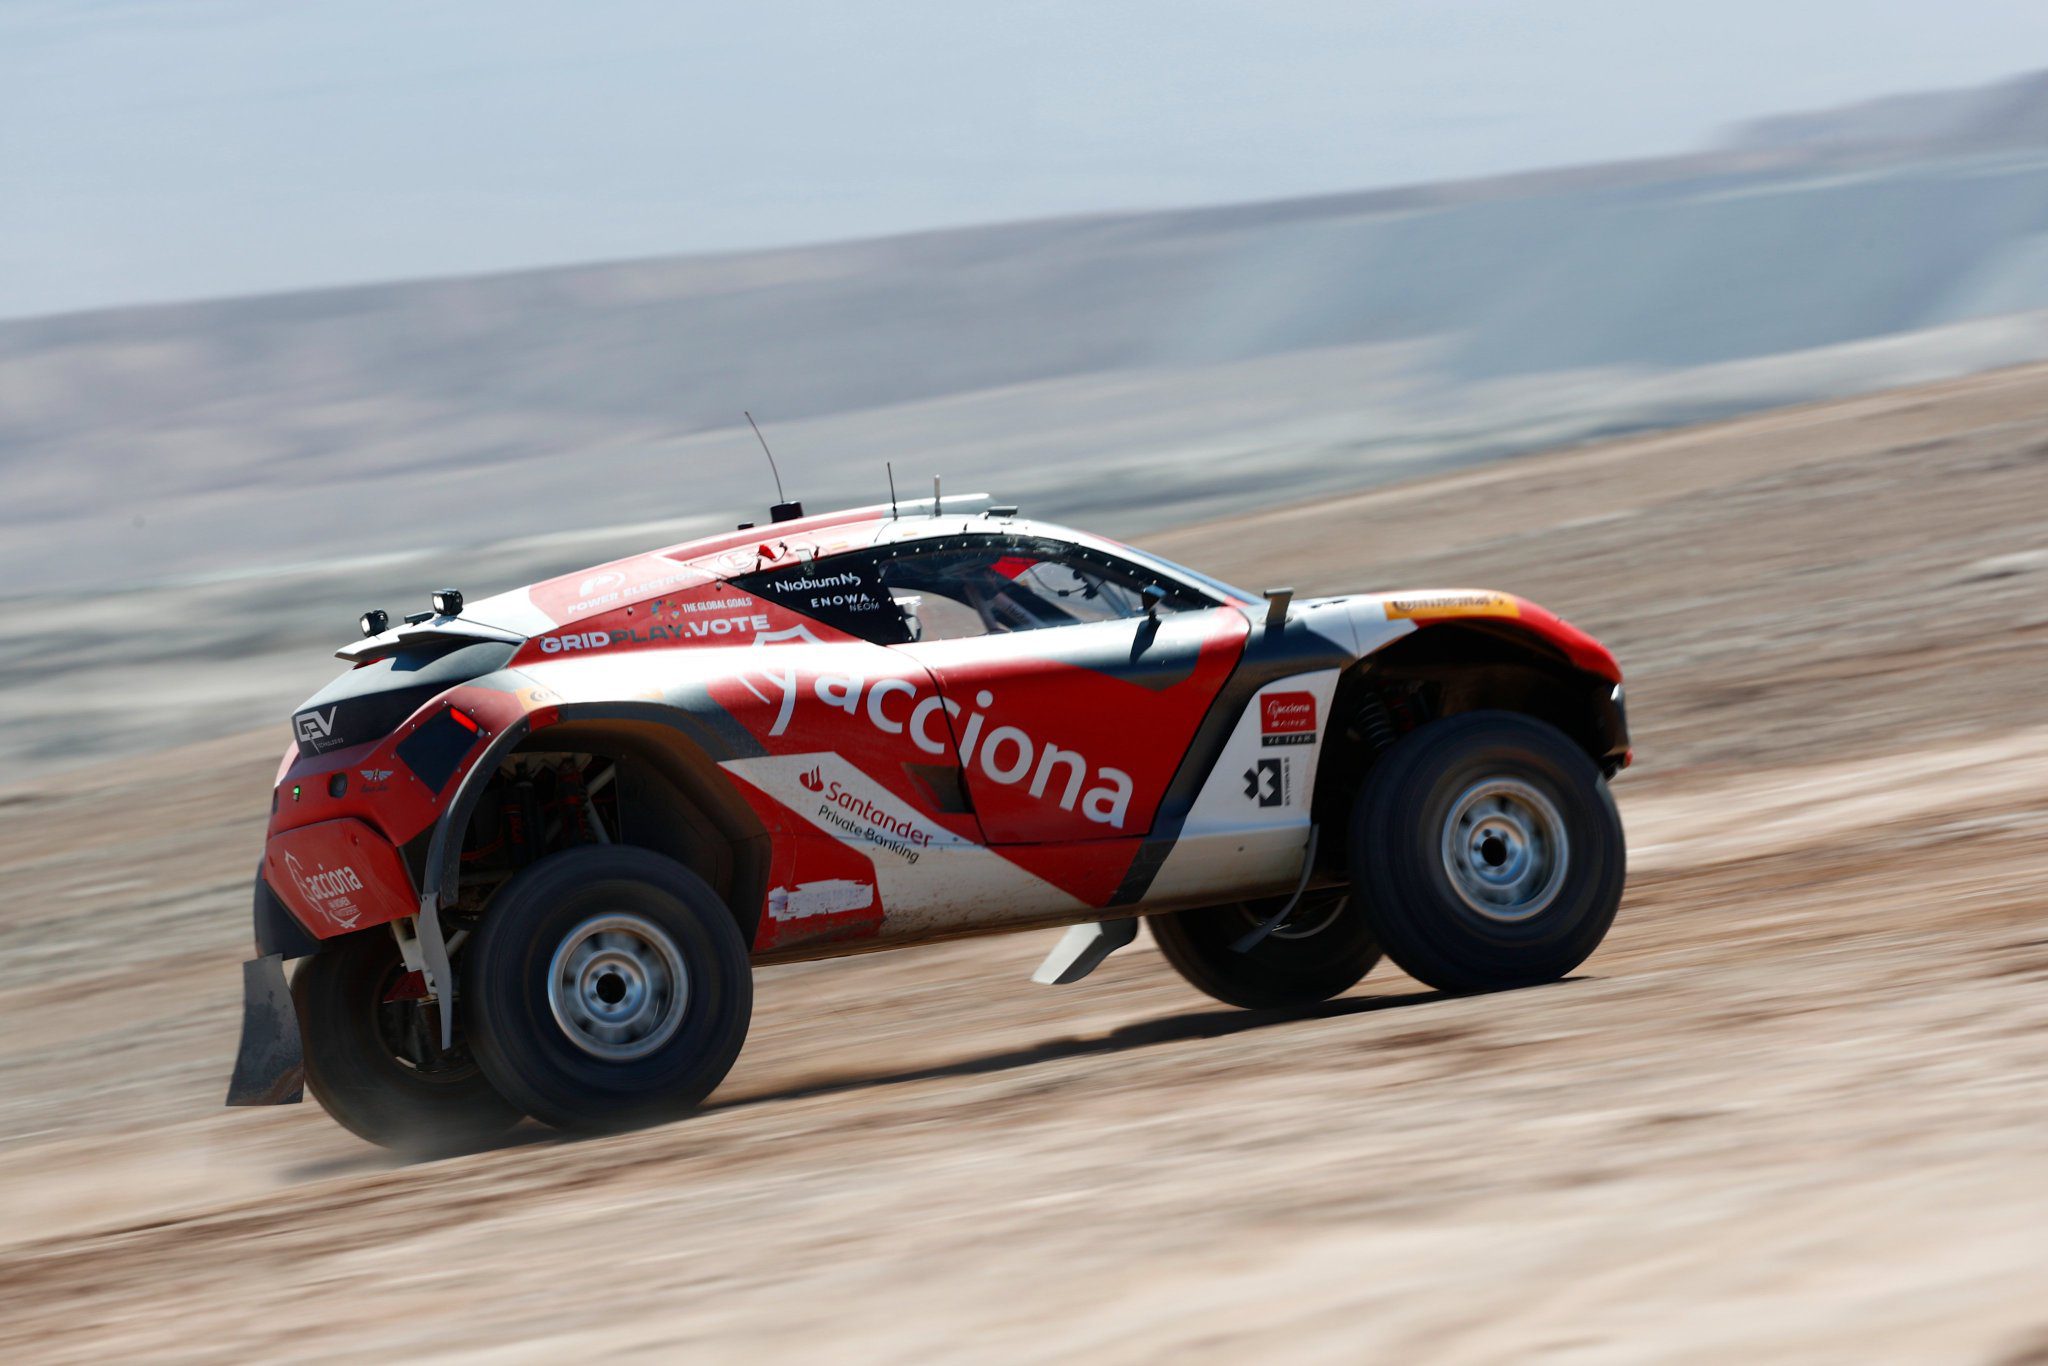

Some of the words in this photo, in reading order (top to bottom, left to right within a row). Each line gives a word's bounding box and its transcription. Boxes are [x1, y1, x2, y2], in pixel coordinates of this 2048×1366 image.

[567, 592, 618, 615] POWER
[682, 602, 697, 614] THE
[698, 600, 727, 612] GLOBAL
[727, 597, 753, 609] GOALS
[849, 602, 879, 612] NEOM
[814, 668, 1133, 828] acciona
[826, 781, 934, 848] Santander
[818, 804, 863, 837] Private
[865, 829, 920, 864] Banking
[306, 863, 363, 900] acciona
